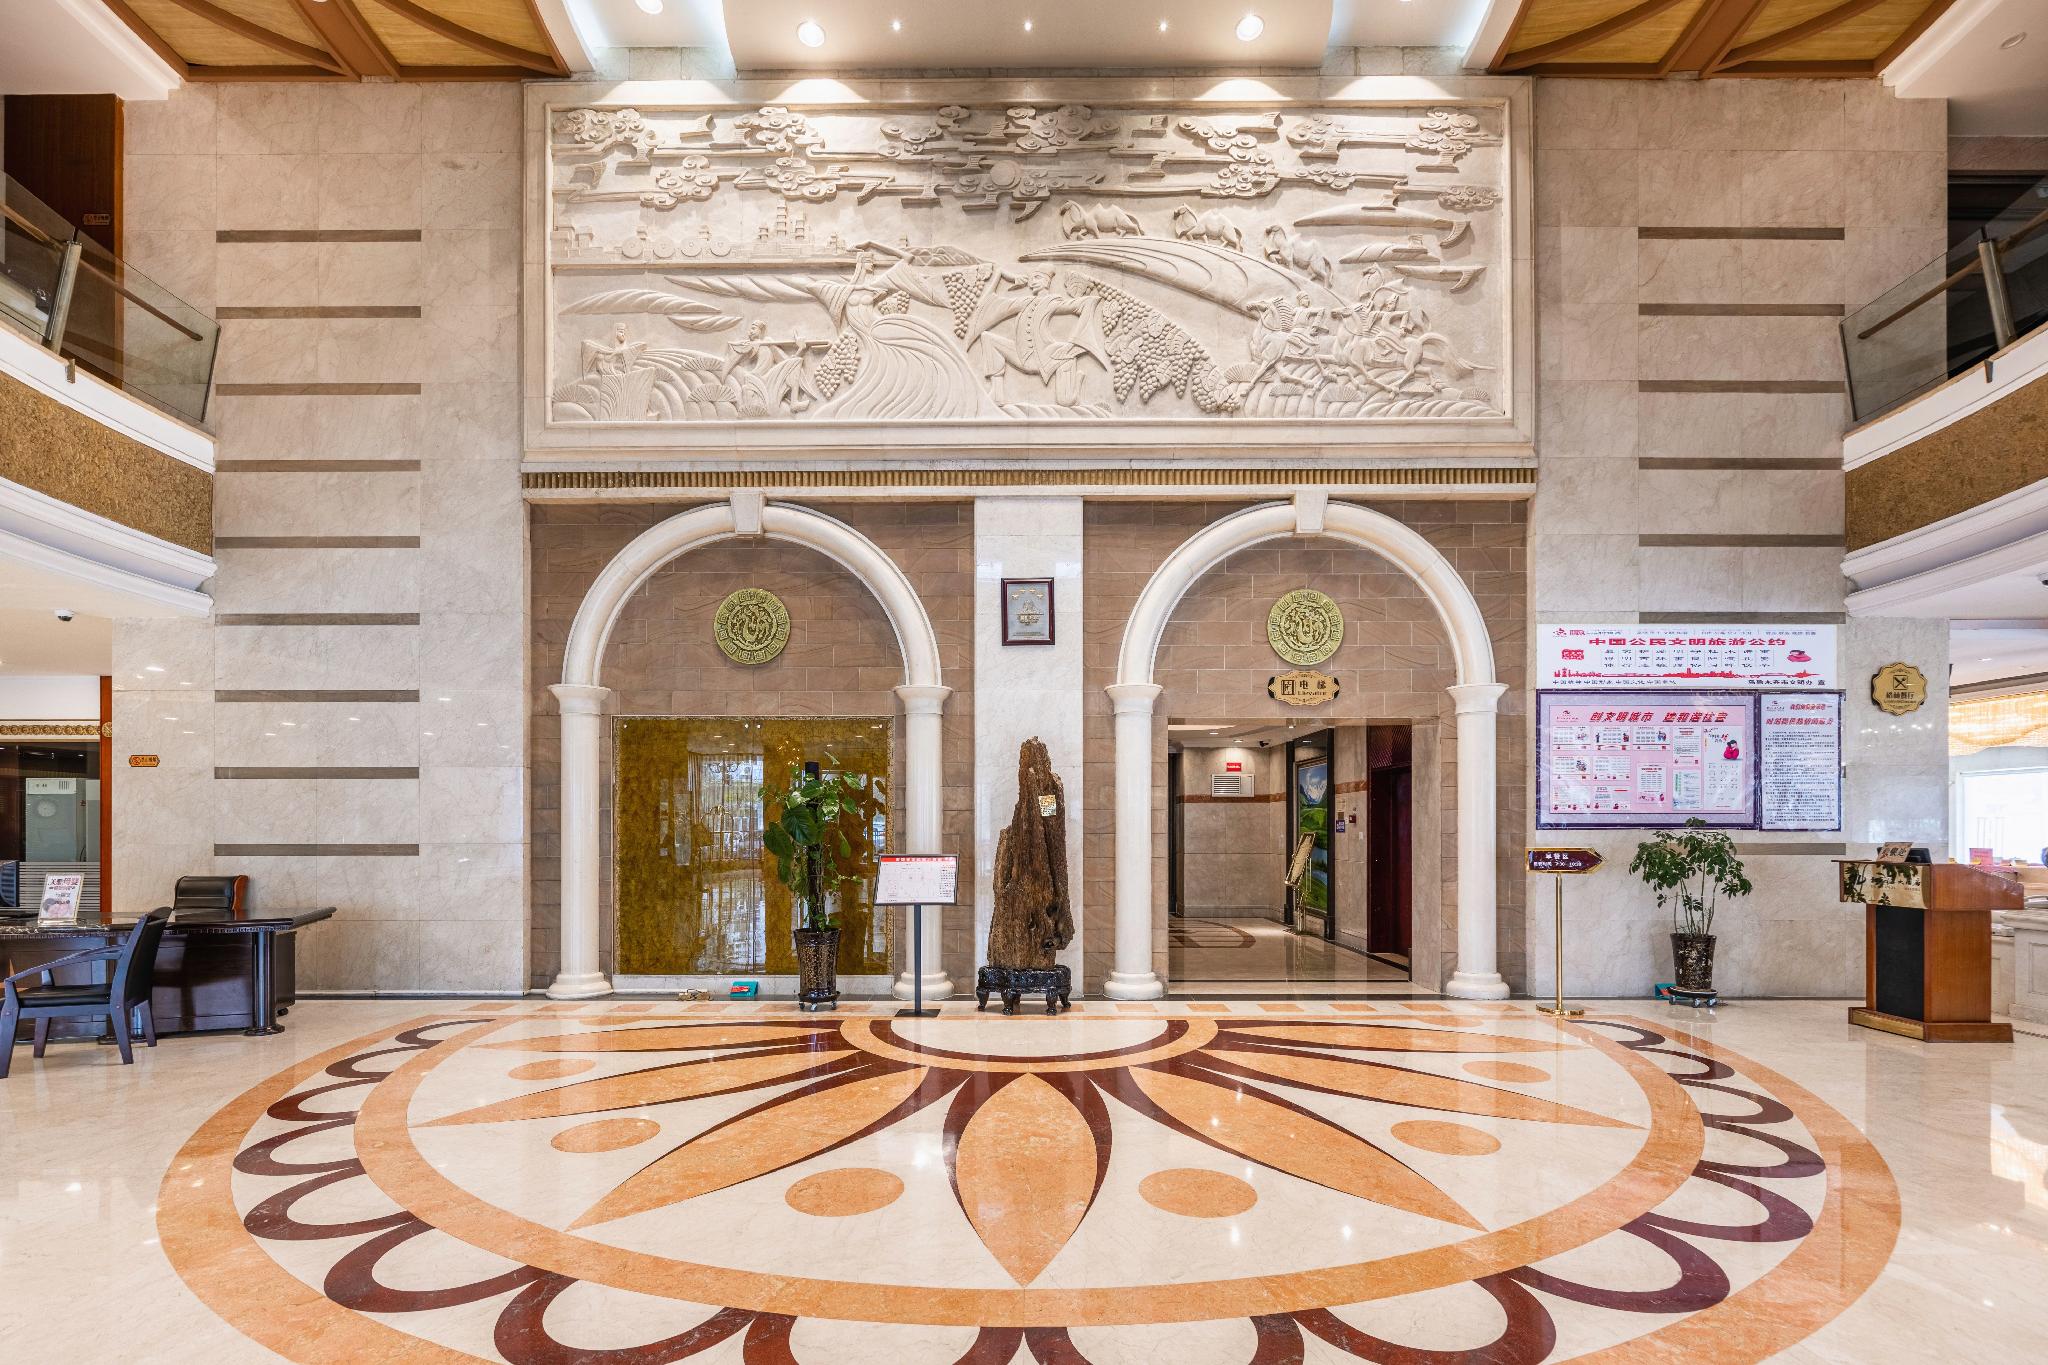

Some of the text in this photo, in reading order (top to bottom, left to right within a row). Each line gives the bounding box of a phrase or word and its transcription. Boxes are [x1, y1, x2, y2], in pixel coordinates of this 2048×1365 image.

[1589, 638, 1786, 646] 中国公民文明旅游公约
[1299, 680, 1327, 690] 电梯
[1590, 712, 1654, 722] 创文明城市
[1662, 712, 1728, 722] 建和谐社会
